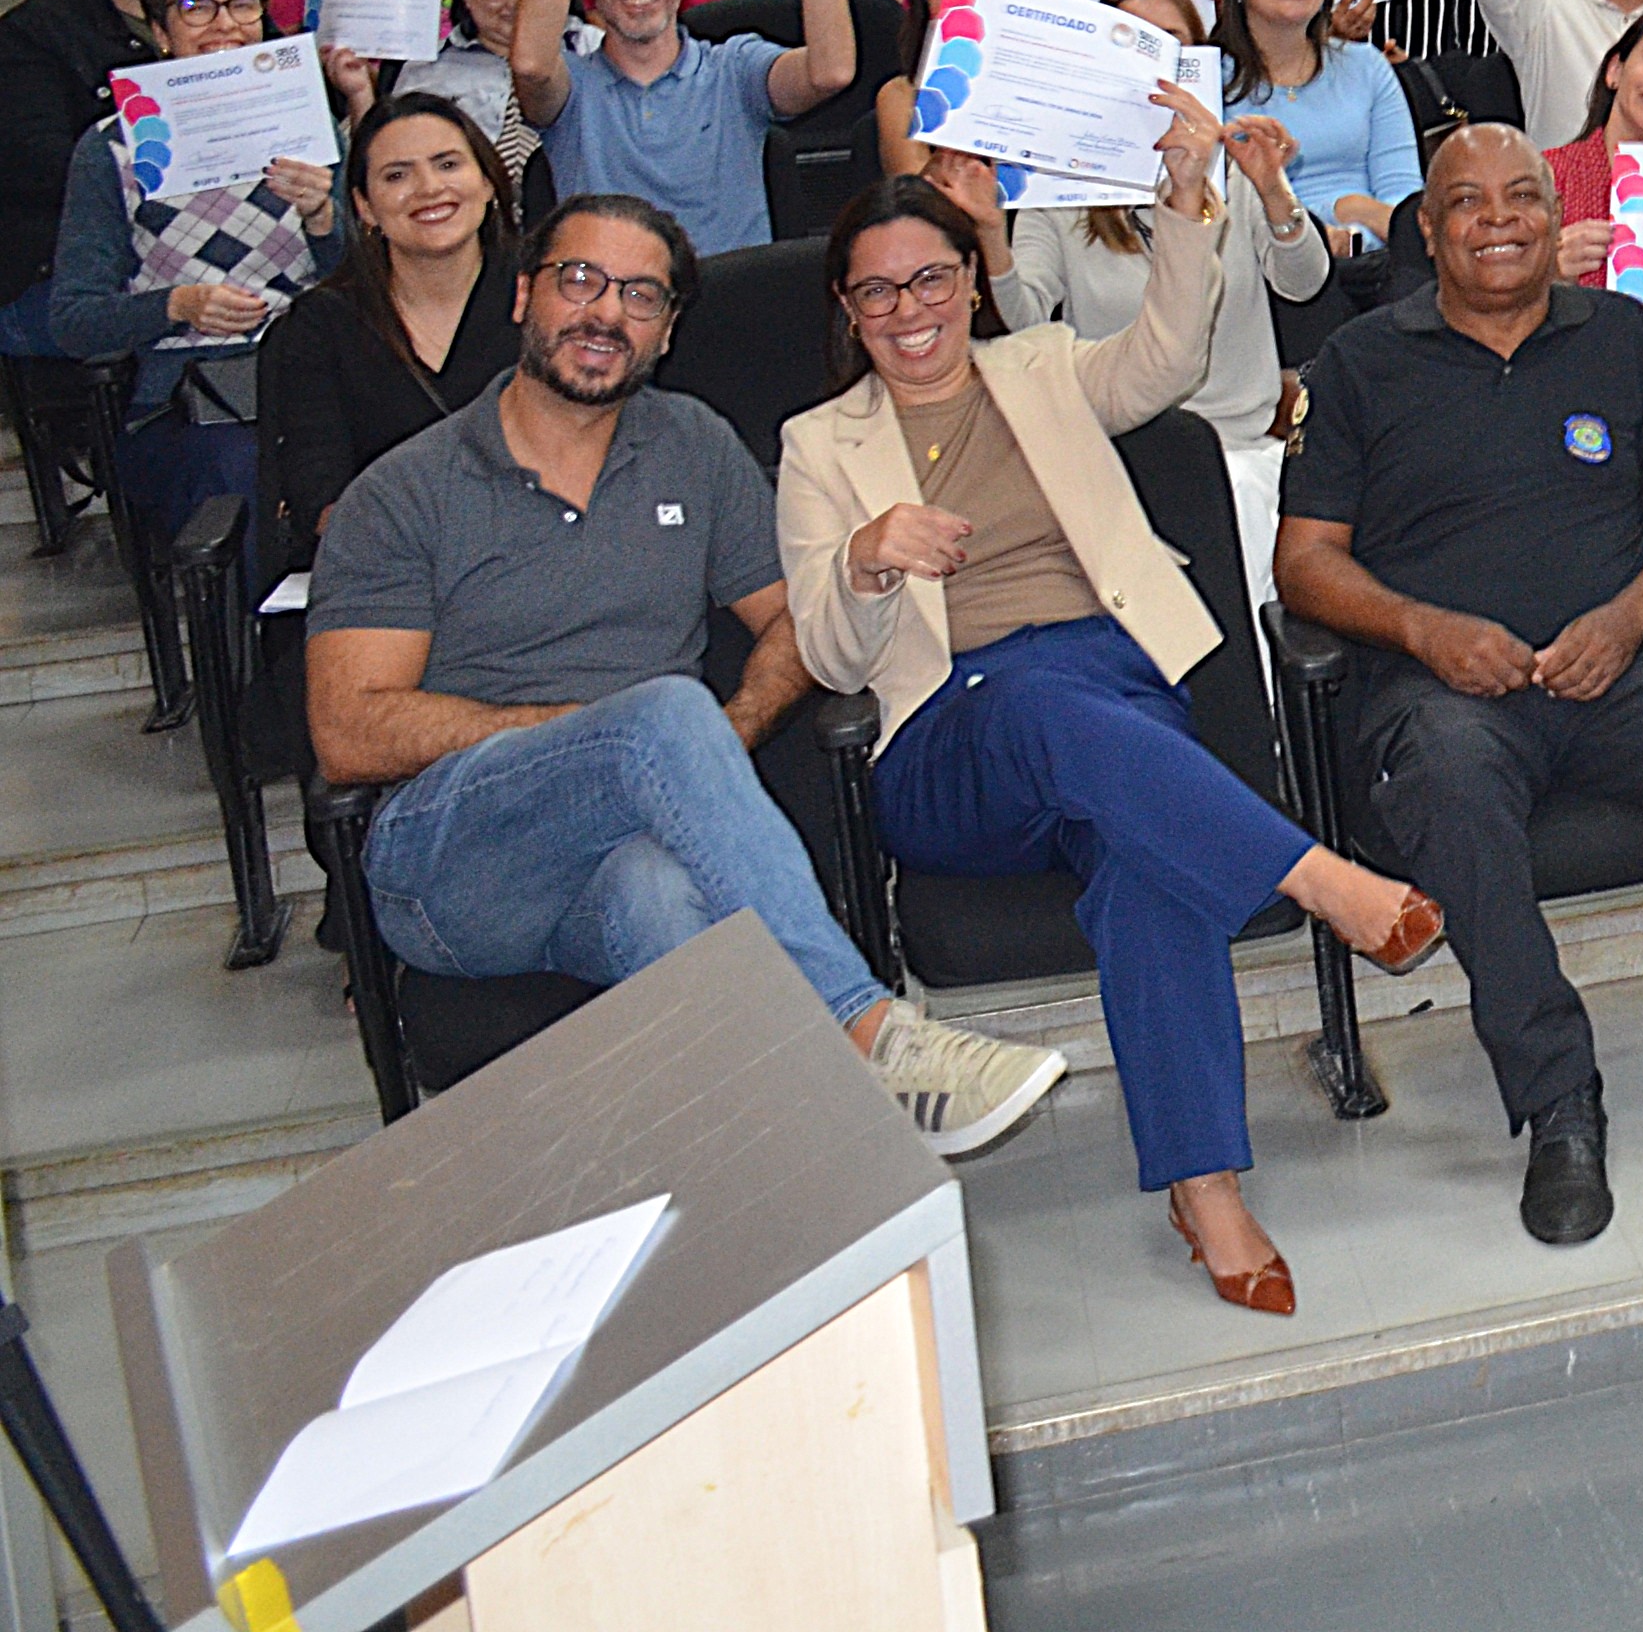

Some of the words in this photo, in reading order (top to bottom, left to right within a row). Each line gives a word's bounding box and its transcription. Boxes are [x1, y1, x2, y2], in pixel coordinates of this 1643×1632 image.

[1006, 4, 1097, 34] CERTIFICADO
[1138, 30, 1163, 48] SELO
[166, 66, 243, 88] CERTIFICADO
[984, 142, 1008, 154] UFU
